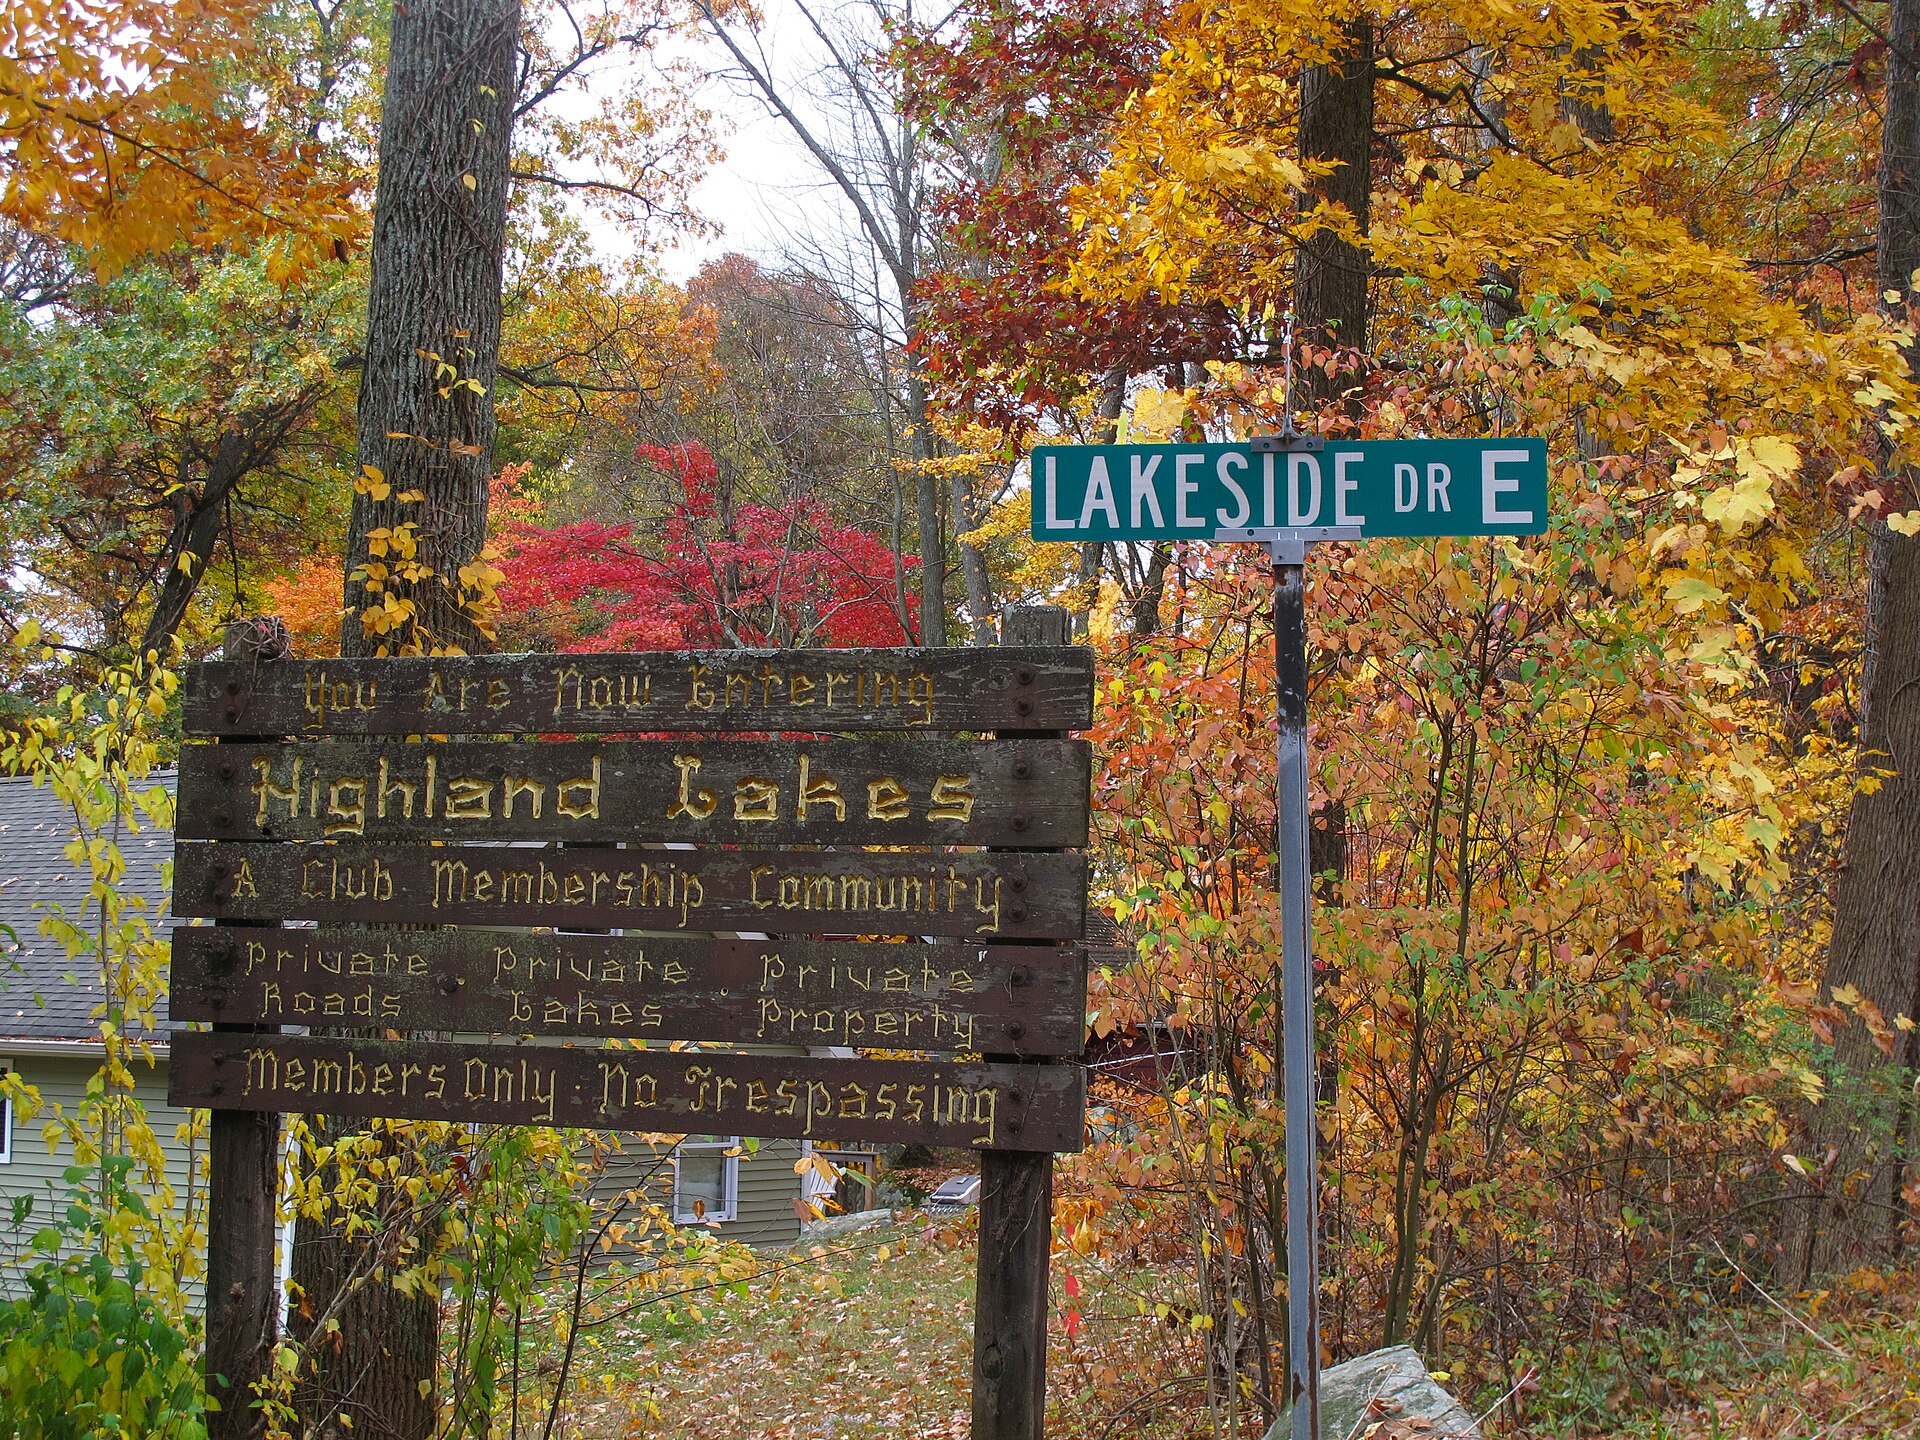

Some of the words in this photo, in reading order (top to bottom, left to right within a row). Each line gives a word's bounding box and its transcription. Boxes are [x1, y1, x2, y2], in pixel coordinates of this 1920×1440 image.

[1044, 451, 1366, 529] LAKESIDE
[1393, 462, 1452, 513] DR
[1481, 449, 1534, 524] E
[302, 670, 378, 730] You
[420, 670, 512, 711] Are
[552, 665, 652, 714] Now
[684, 660, 934, 727] Entering
[250, 753, 602, 837] Highland
[665, 751, 976, 823] Lakes
[230, 856, 261, 899] A
[300, 857, 394, 901] Club
[430, 857, 705, 930] Membership
[749, 862, 1003, 934] Community
[245, 940, 430, 977] Private
[493, 944, 689, 984] Private
[759, 951, 975, 993] Private
[261, 980, 402, 1019] Roads
[508, 988, 663, 1027] Lakes
[756, 996, 975, 1050] Property
[241, 1046, 447, 1099] Members
[462, 1056, 557, 1122] Only
[597, 1060, 659, 1115] No
[684, 1063, 999, 1146] Trespassing
